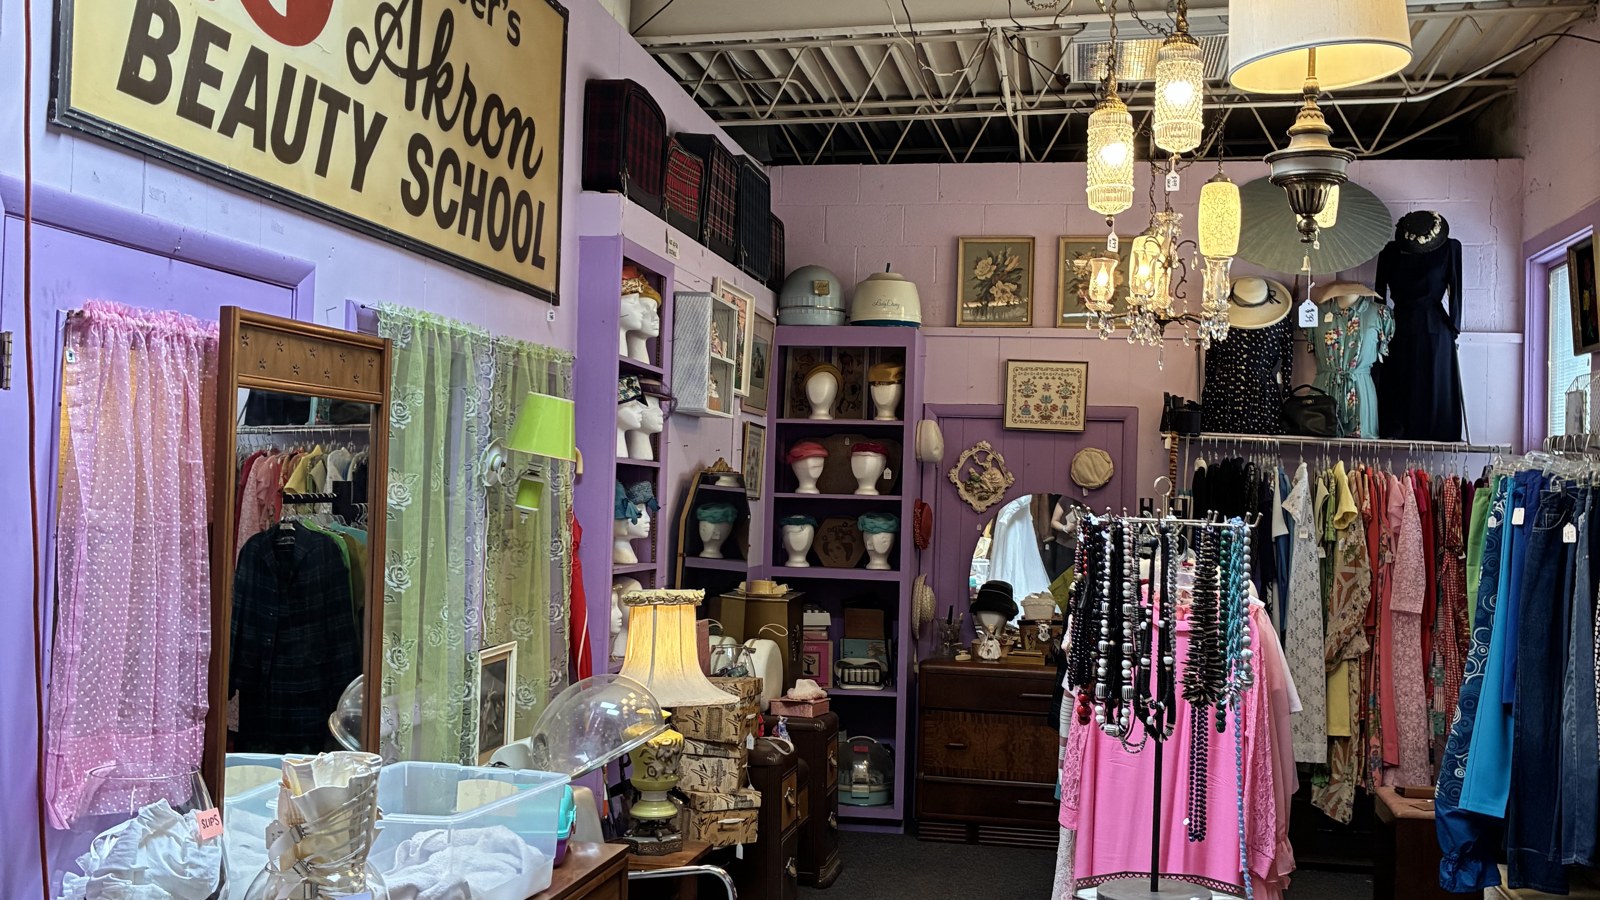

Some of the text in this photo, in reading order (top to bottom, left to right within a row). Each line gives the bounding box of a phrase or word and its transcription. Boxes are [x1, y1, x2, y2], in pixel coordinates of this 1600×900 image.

[459, 0, 521, 47] er's
[116, 0, 546, 271] BEAUTY SCHOOL
[346, 0, 544, 180] Akron
[201, 814, 220, 830] SLIPS
